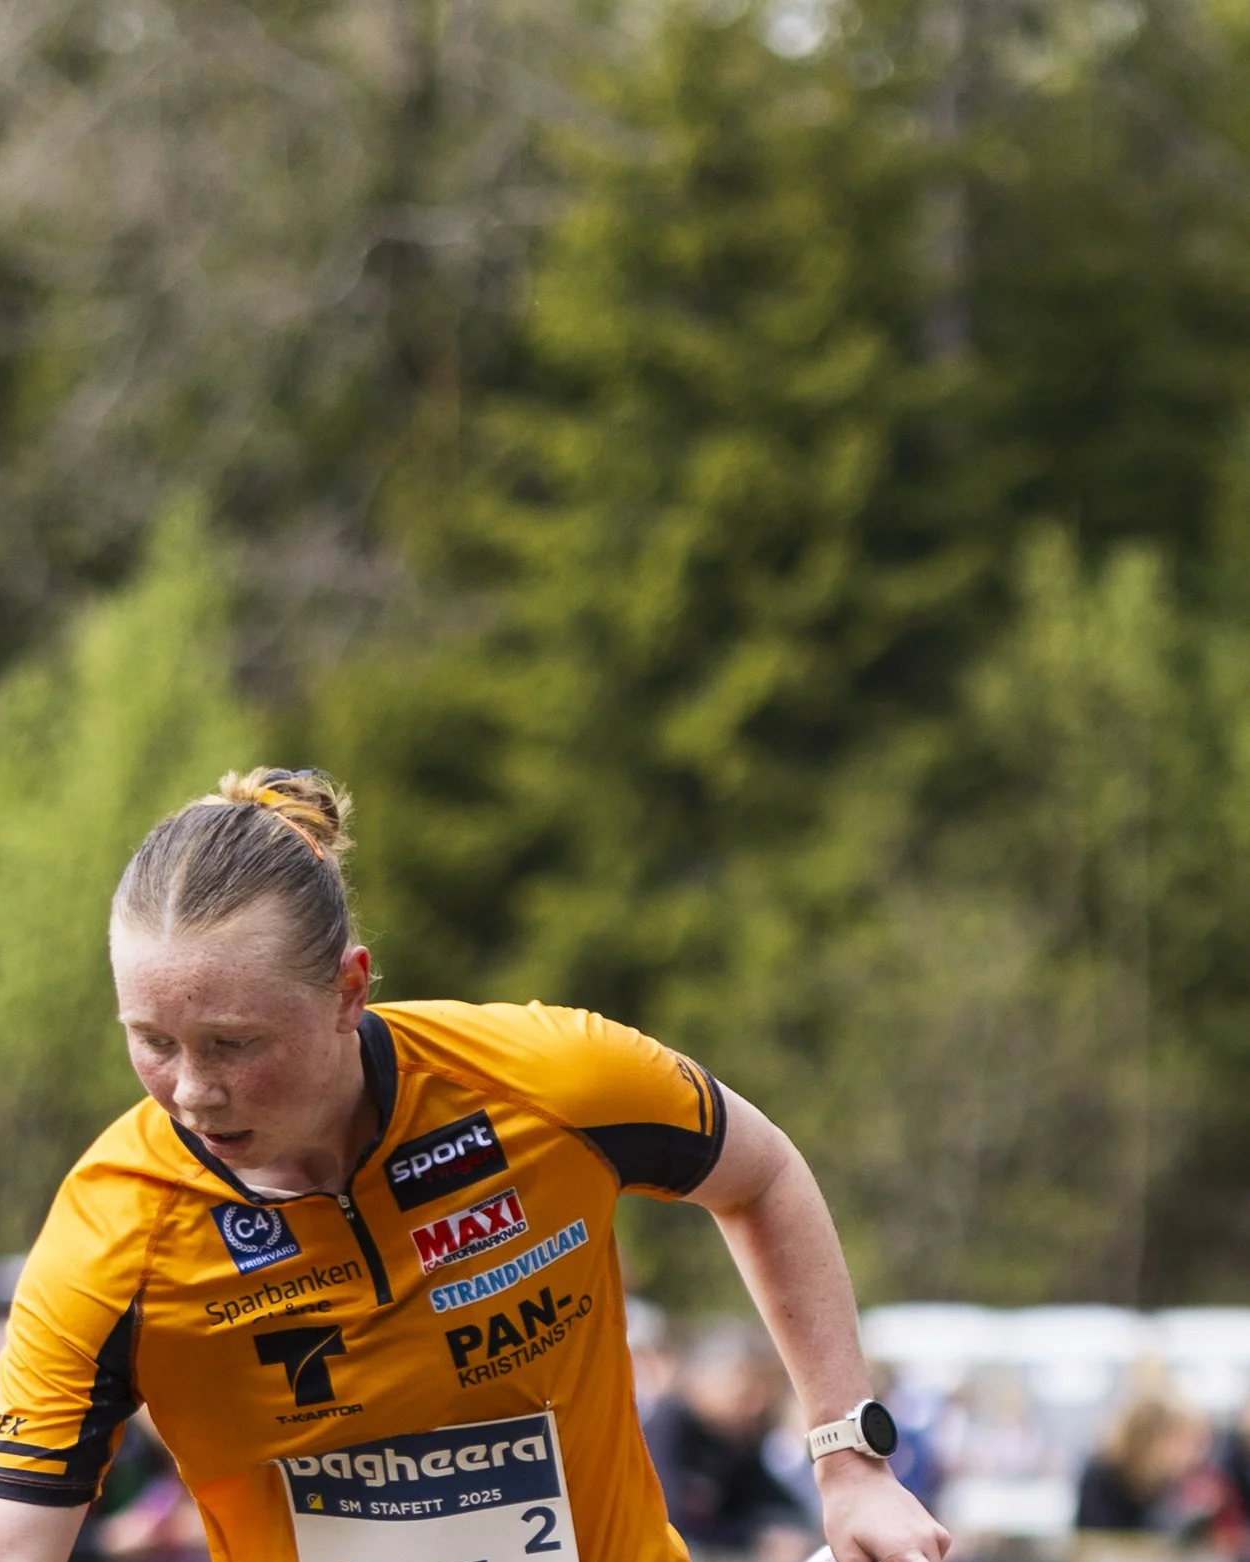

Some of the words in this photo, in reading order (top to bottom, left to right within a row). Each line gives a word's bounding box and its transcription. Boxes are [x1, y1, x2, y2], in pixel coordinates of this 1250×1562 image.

[391, 1125, 492, 1183] sport
[235, 1212, 270, 1239] C4
[412, 1195, 524, 1263] MAXI
[442, 1221, 527, 1264] STORMARKNAD
[431, 1221, 587, 1310] STRANDVILLAN
[205, 1260, 363, 1326] Sparbanken
[445, 1287, 572, 1369] PAN-
[275, 1403, 364, 1425] T-KARTOR
[288, 1435, 549, 1487] bagheera
[340, 1499, 362, 1513] SM
[371, 1499, 444, 1516] STAFETT
[459, 1488, 503, 1508] 2025
[521, 1506, 562, 1555] 2
